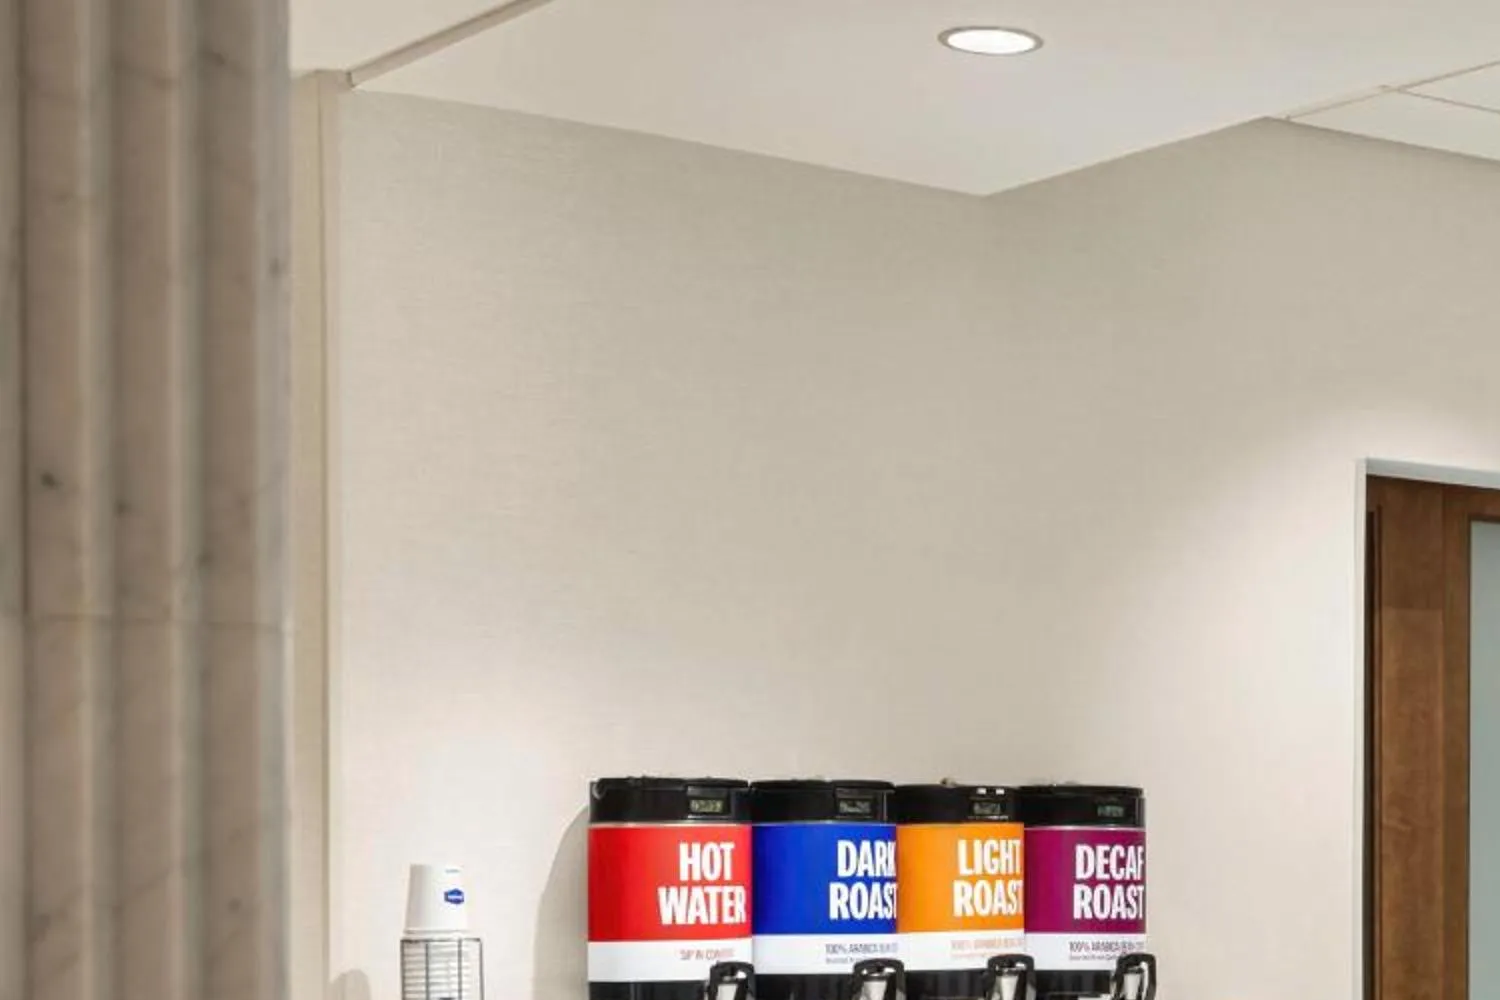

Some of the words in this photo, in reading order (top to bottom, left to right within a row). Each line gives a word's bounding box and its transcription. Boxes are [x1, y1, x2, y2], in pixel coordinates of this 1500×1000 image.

[679, 841, 735, 881] HOT
[837, 839, 897, 877] DARK
[957, 838, 1021, 875] LIGHT
[1075, 843, 1144, 880] DECAF
[658, 885, 747, 925] WATER
[829, 882, 898, 920] ROAST
[953, 879, 1024, 917] ROAST
[1073, 883, 1144, 920] ROAST
